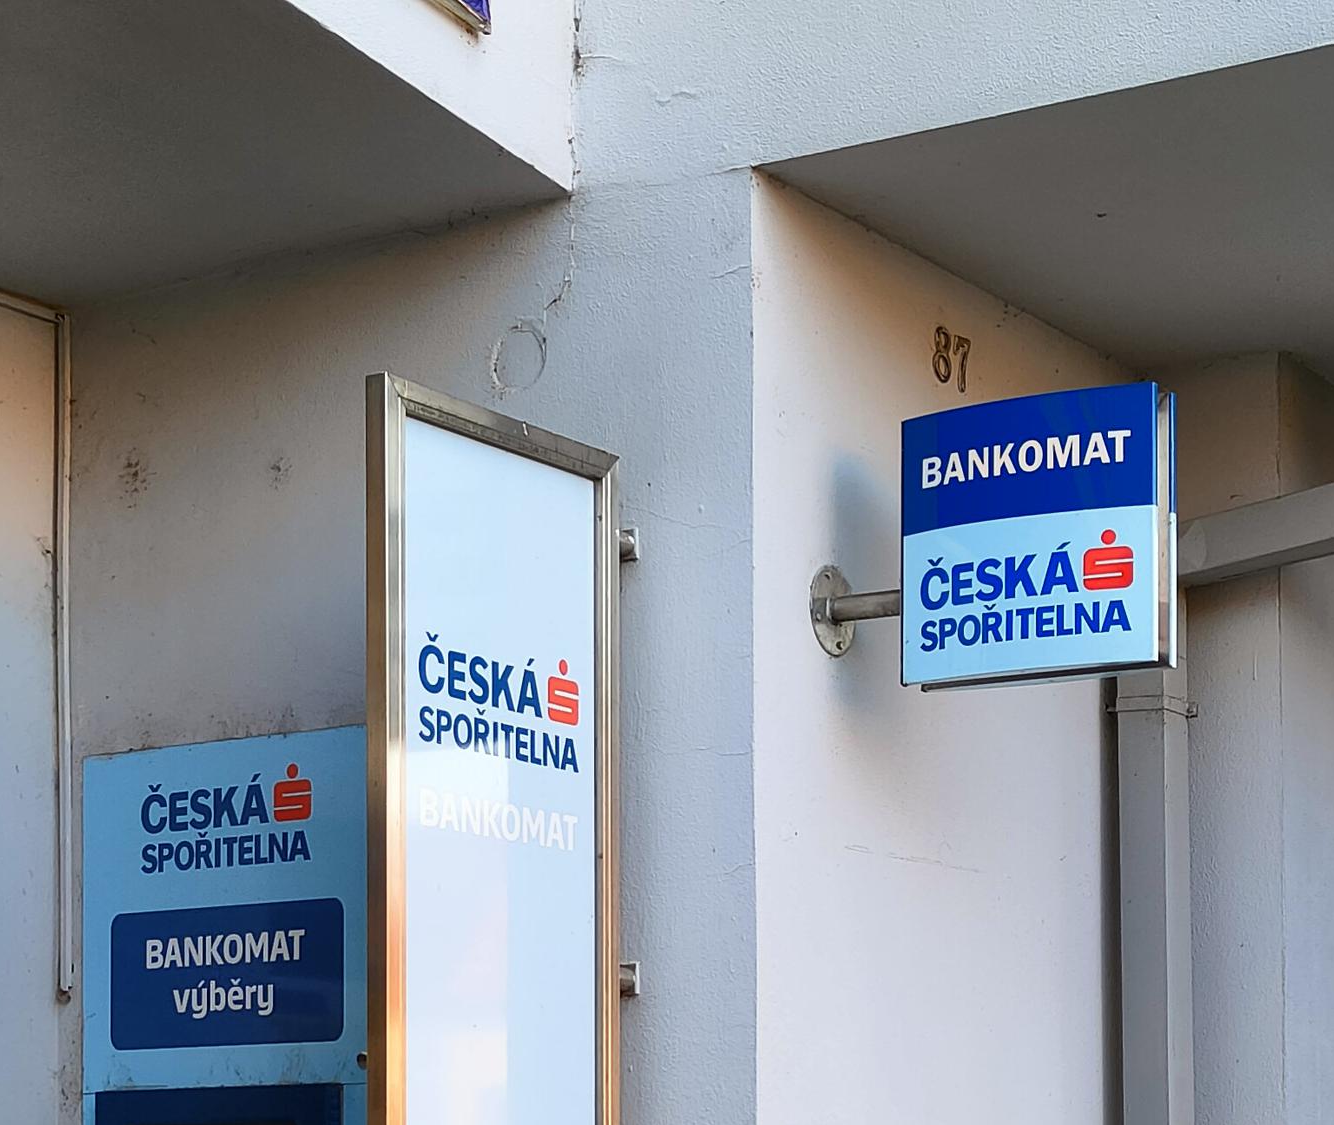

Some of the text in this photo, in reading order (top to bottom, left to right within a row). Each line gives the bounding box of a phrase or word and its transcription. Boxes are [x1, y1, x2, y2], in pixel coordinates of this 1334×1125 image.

[931, 326, 971, 393] 87
[921, 429, 1131, 489] BANKOMAT
[920, 541, 1079, 611] ČESKÁ
[920, 600, 1131, 652] SPOŘITELNA
[418, 631, 543, 718] ČESKÁ
[419, 705, 579, 773] SPOŘITELNA
[141, 773, 269, 834] ČESKÁ
[419, 787, 578, 851] BANKOMAT
[141, 830, 311, 874] SPOŘITELNA
[145, 929, 305, 969] BANKOMAT
[173, 978, 274, 1019] výběry
